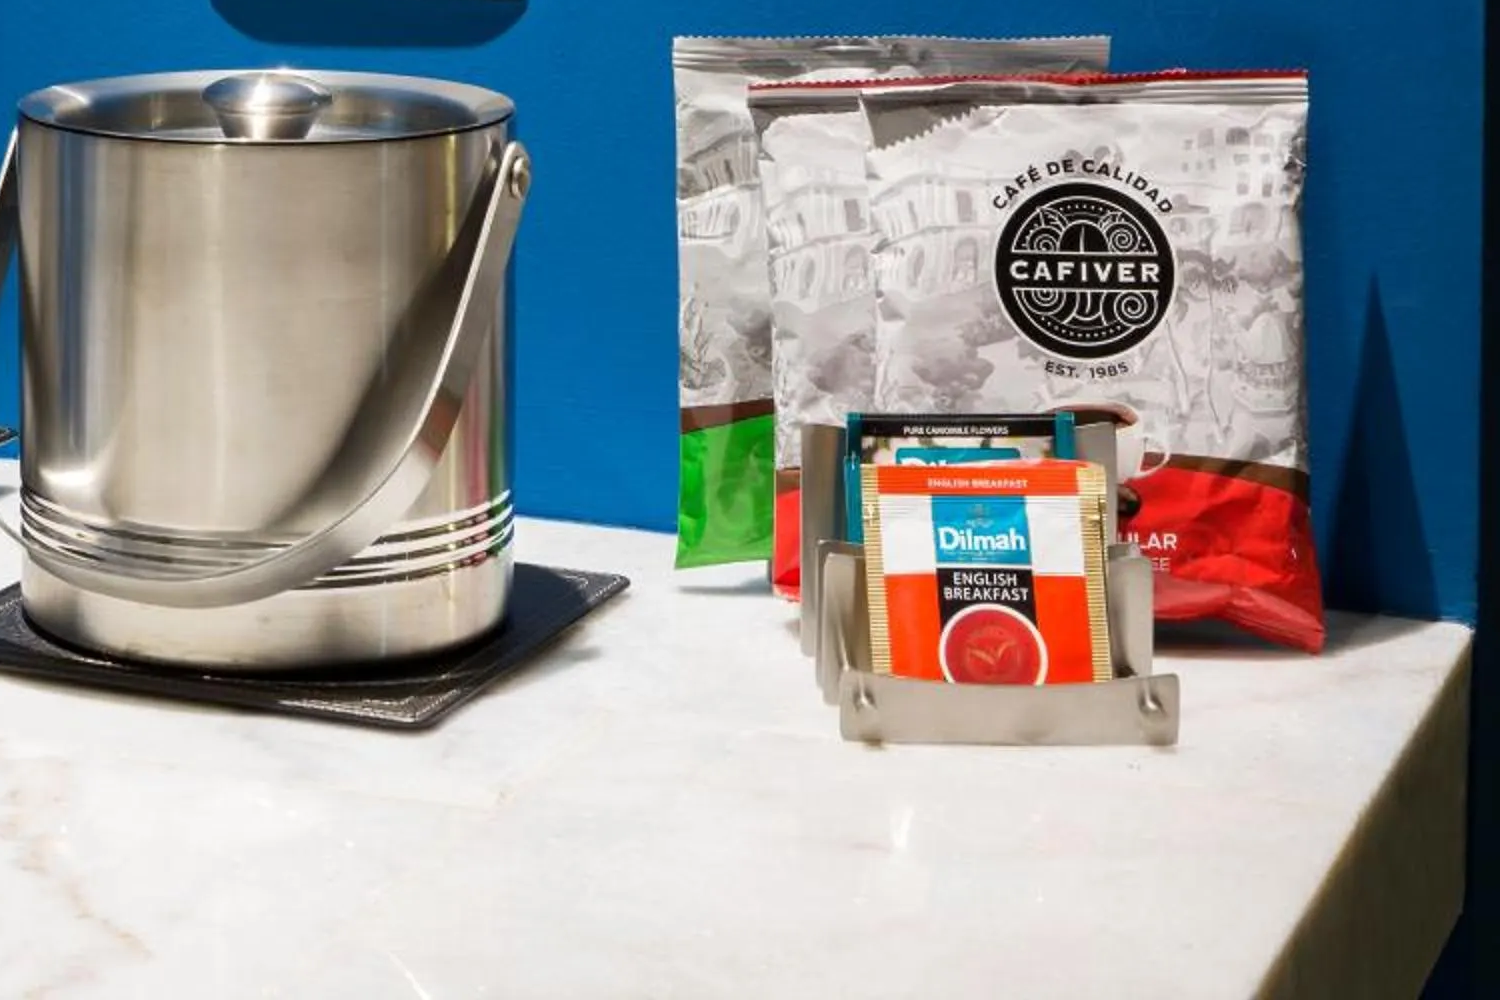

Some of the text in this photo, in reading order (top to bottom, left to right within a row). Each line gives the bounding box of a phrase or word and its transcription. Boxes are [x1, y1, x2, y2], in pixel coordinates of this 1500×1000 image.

[992, 158, 1174, 214] CAFÉ DE CALIDAD
[1008, 259, 1160, 283] CAFIVER
[1044, 361, 1130, 379] EST. 1985
[902, 425, 925, 436] PURE
[970, 425, 1010, 436] FLOWERS
[927, 477, 1029, 490] ENGLISH BREAKFAST
[937, 525, 1027, 551] Dilmah
[952, 571, 1018, 587] ENGLISH
[943, 586, 1030, 601] BREAKFAST
